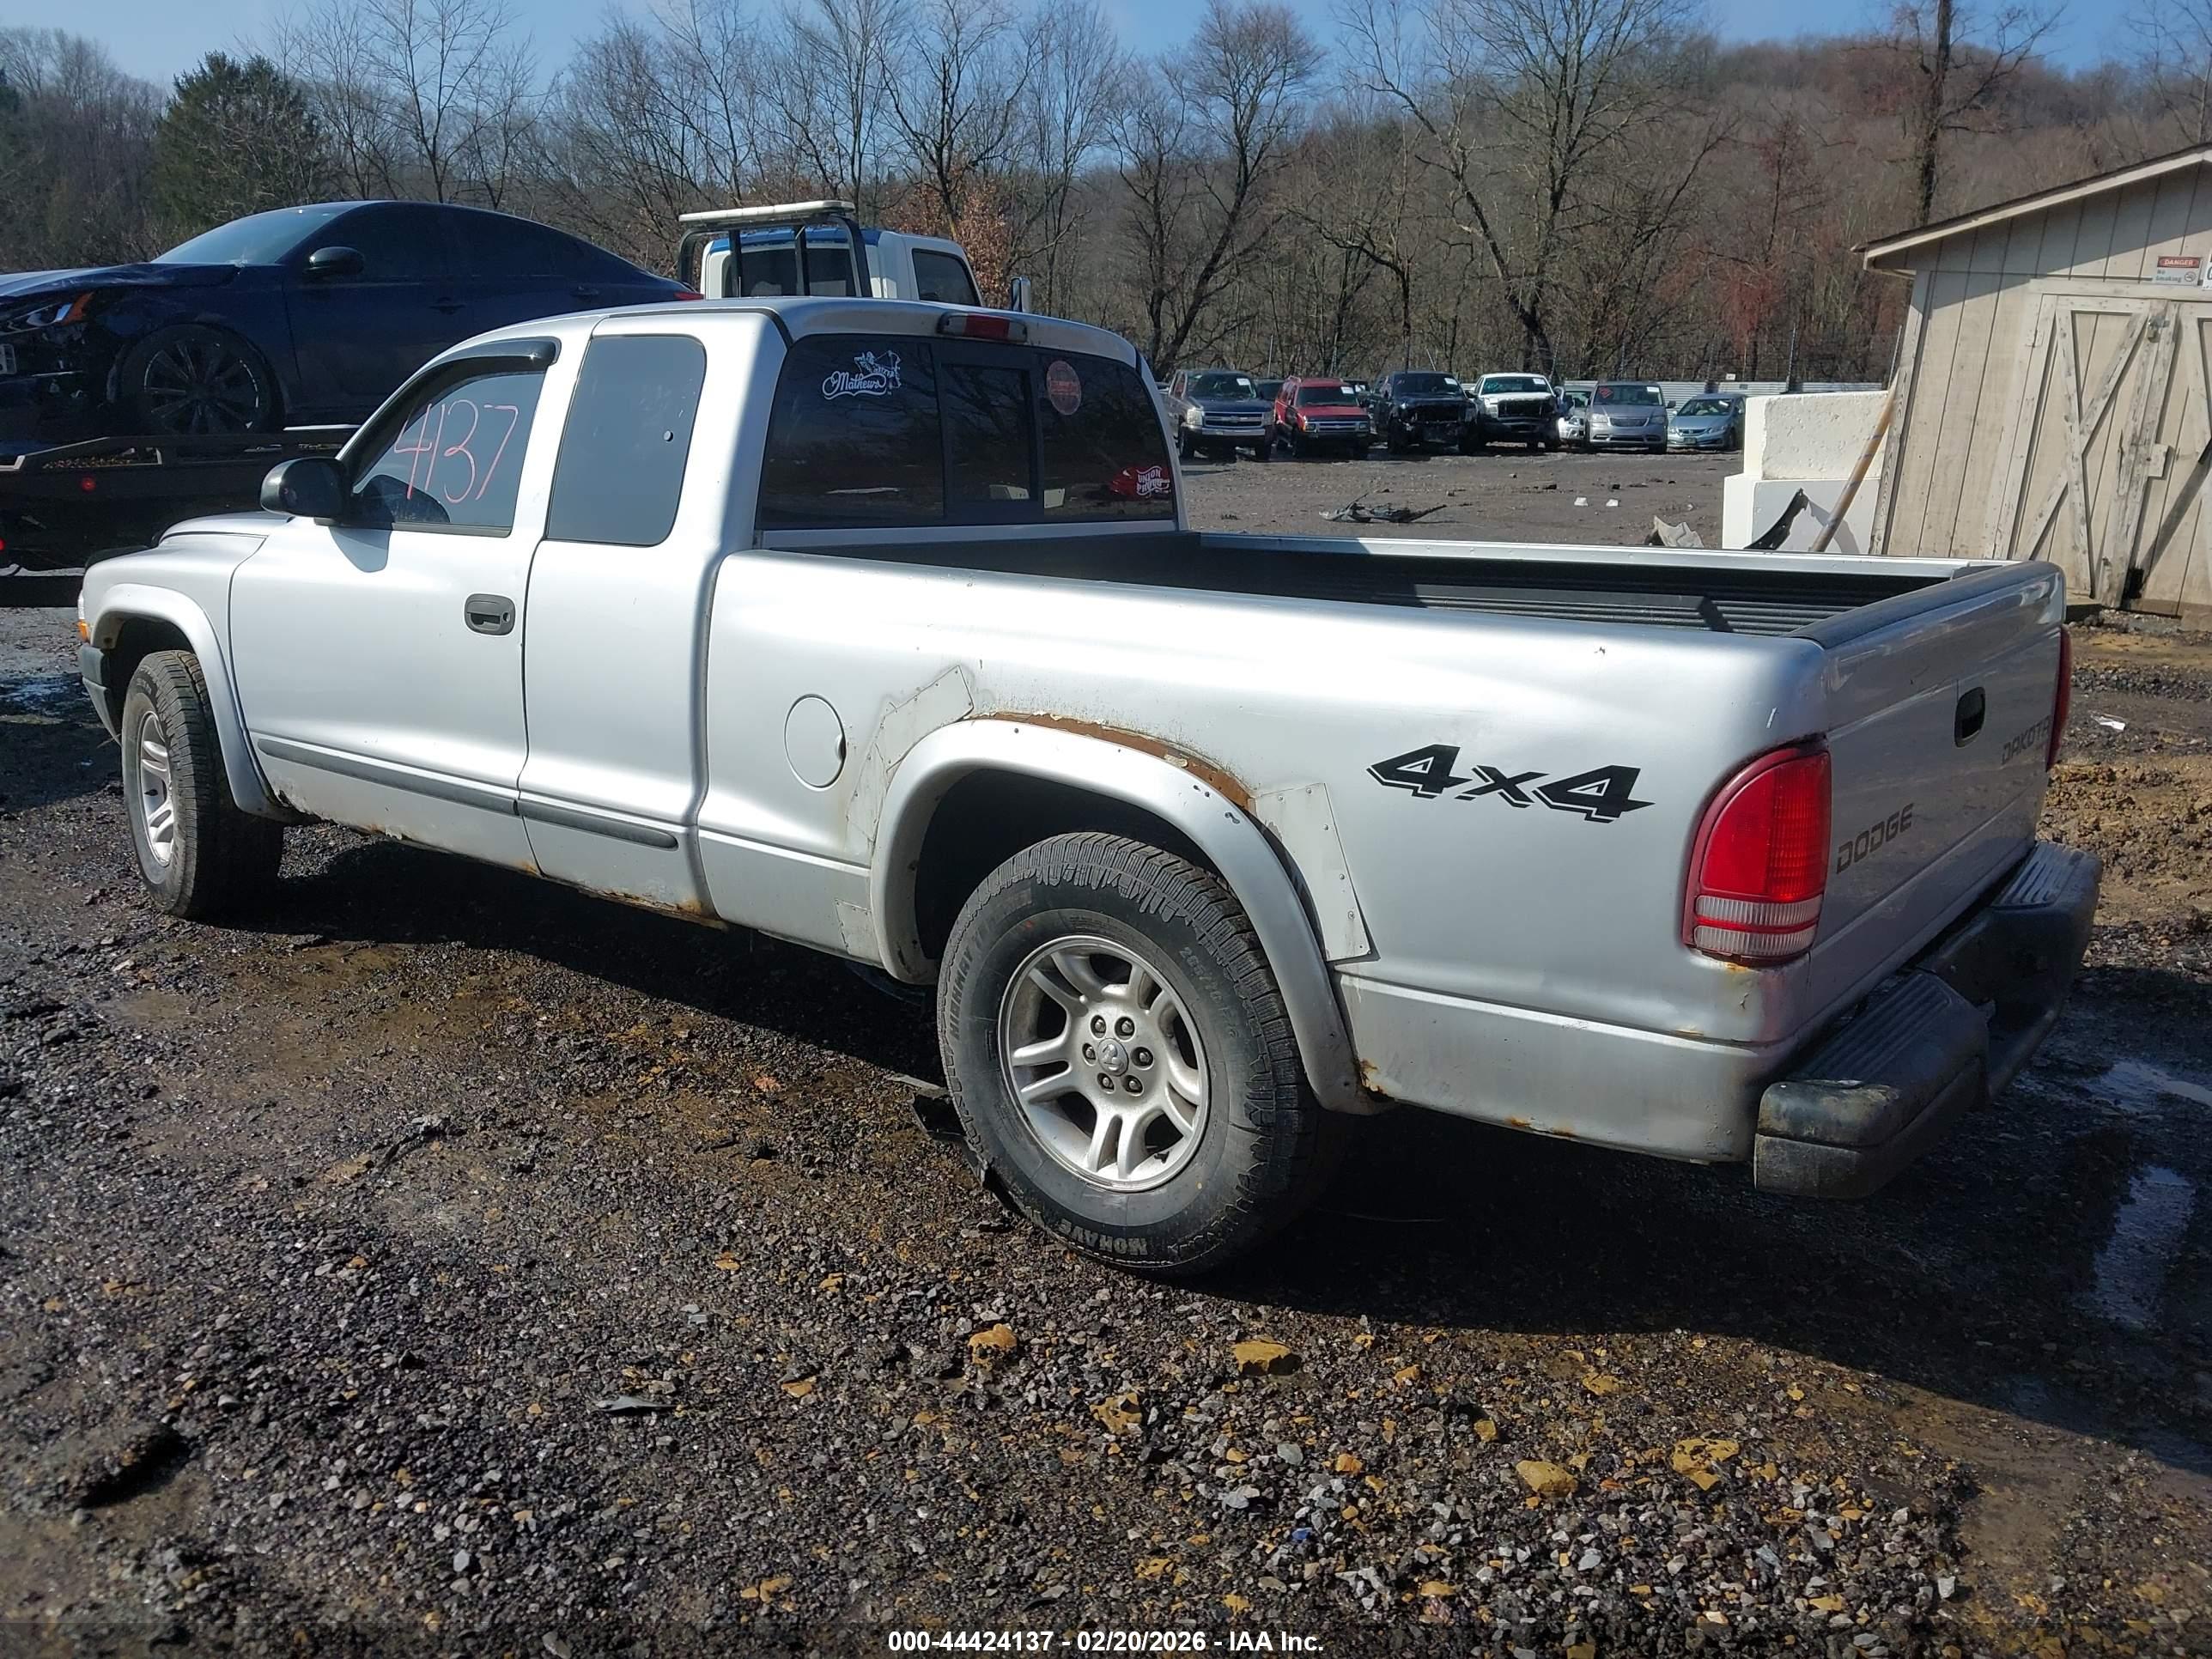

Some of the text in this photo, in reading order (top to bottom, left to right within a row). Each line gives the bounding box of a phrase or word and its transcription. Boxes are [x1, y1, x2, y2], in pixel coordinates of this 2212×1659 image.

[822, 370, 887, 397] Mathews
[393, 399, 519, 503] 4137
[1137, 468, 1162, 483] UNION
[2001, 714, 2052, 766] DAKOTA
[1837, 803, 1915, 874] DODGE
[1057, 1218, 1148, 1255] MOHAVE
